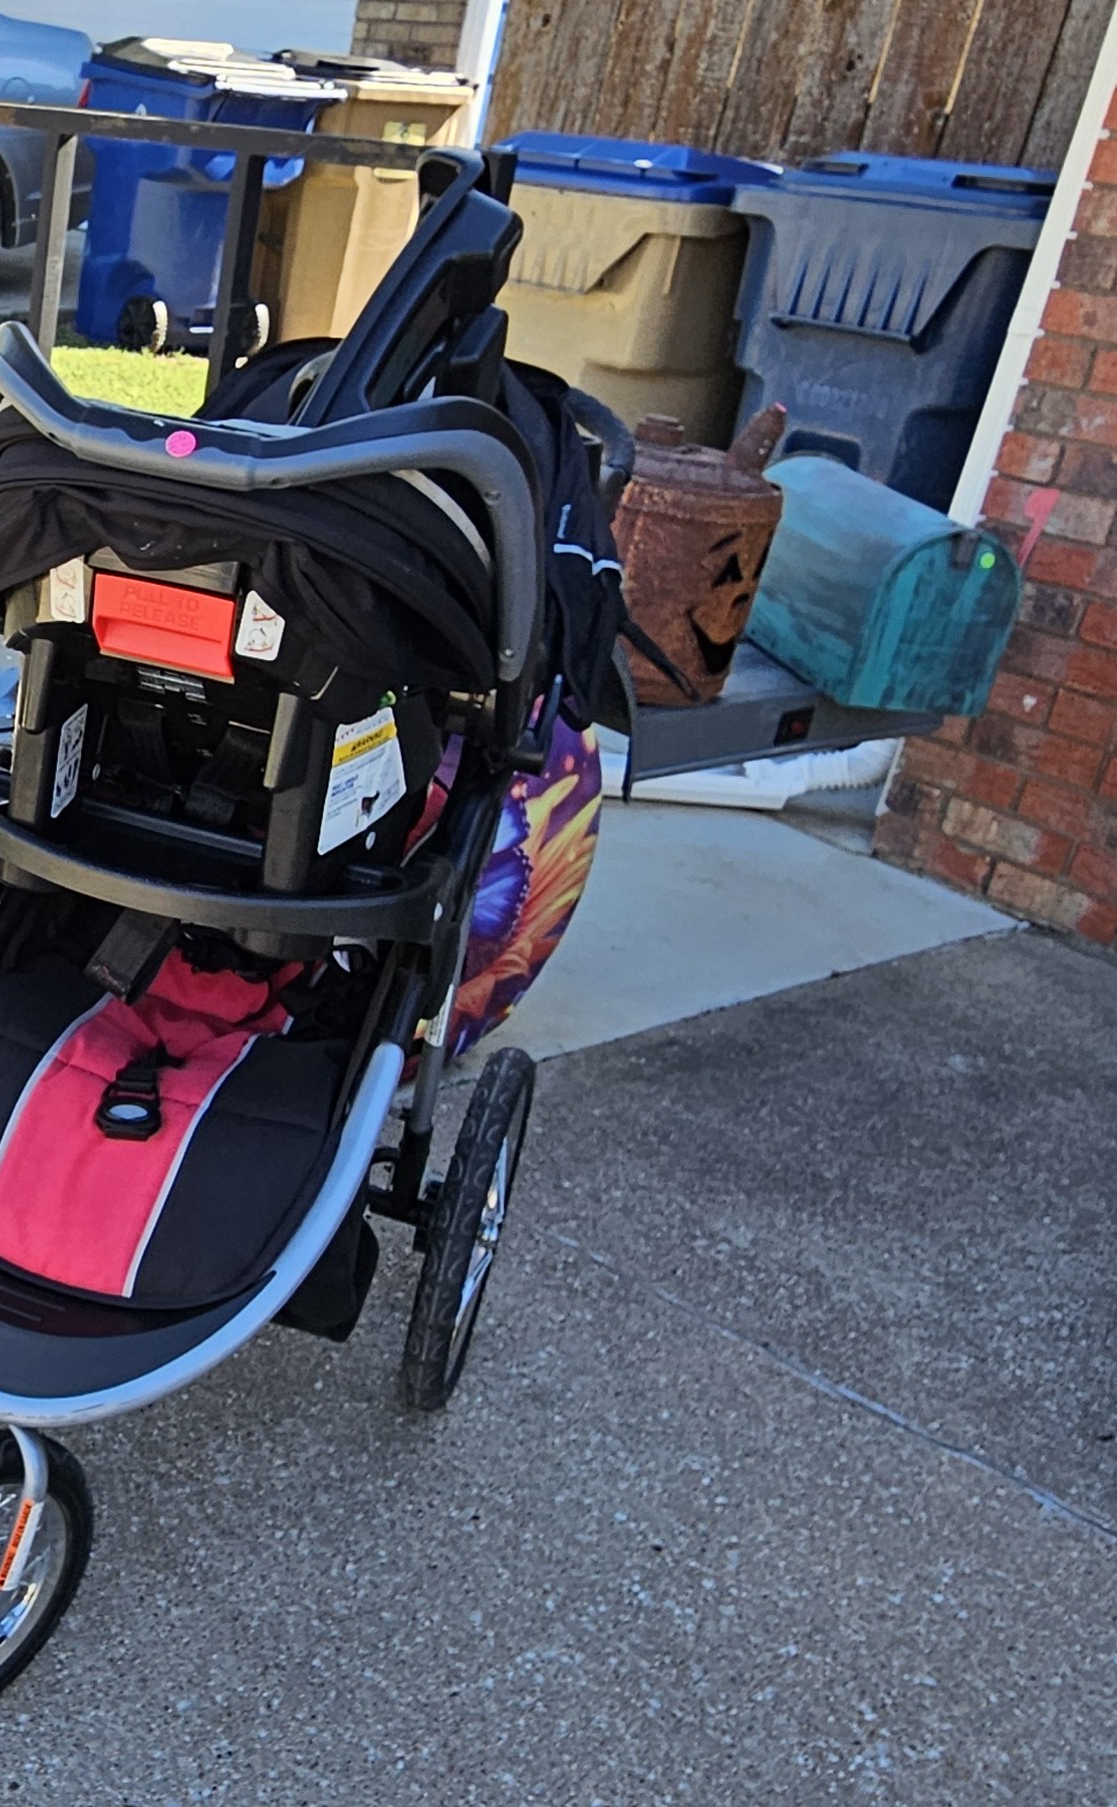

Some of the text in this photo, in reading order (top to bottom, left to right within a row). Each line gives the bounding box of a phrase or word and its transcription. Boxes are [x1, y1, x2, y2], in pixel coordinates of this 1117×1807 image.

[123, 585, 200, 612] PULL TO
[120, 602, 200, 631] RELEASE
